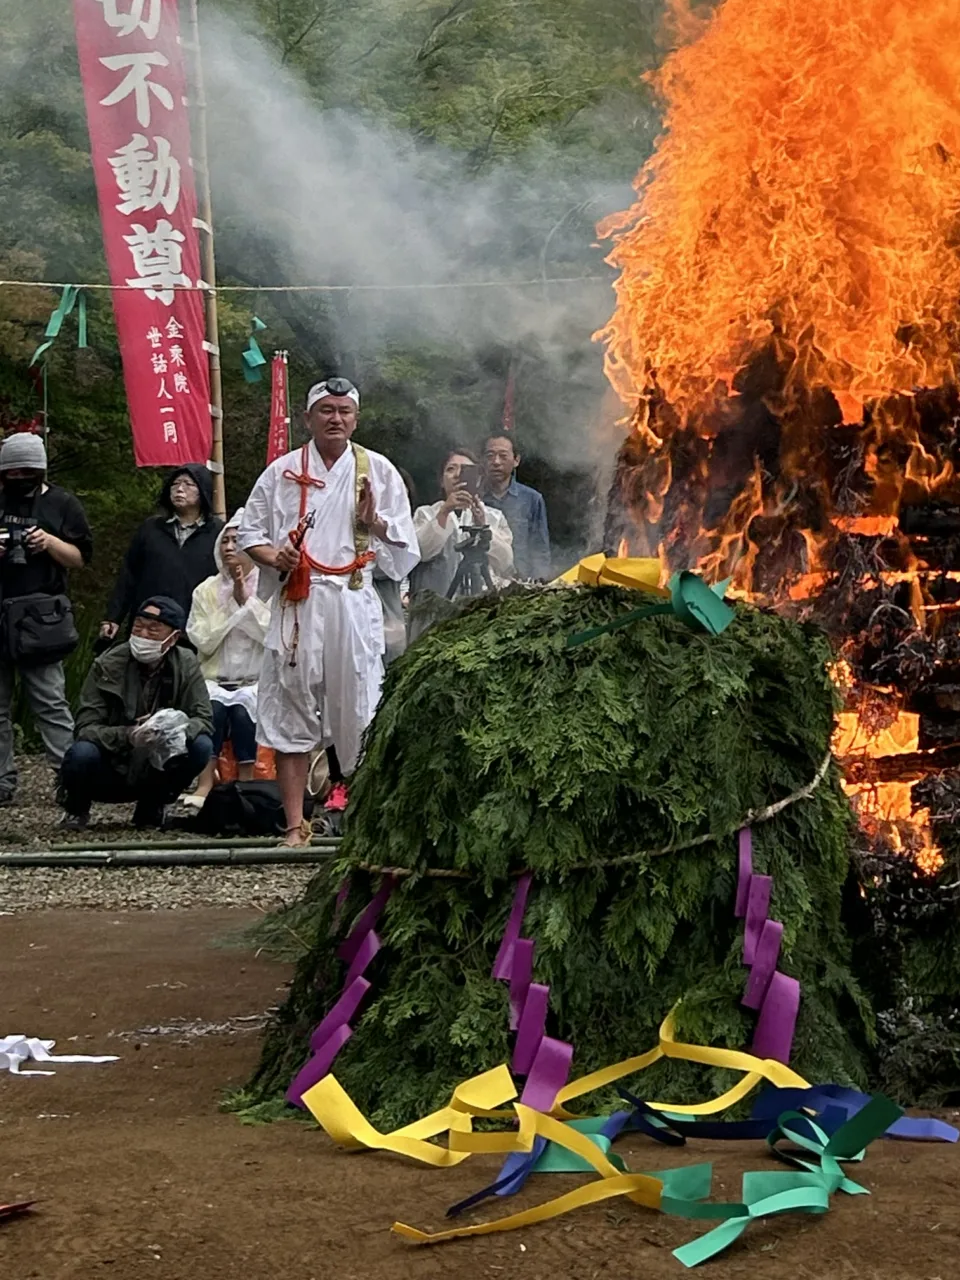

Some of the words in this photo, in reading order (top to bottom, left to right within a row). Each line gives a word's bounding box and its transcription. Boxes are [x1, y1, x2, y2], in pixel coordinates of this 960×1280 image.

[146, 326, 178, 444] 世話人一同
